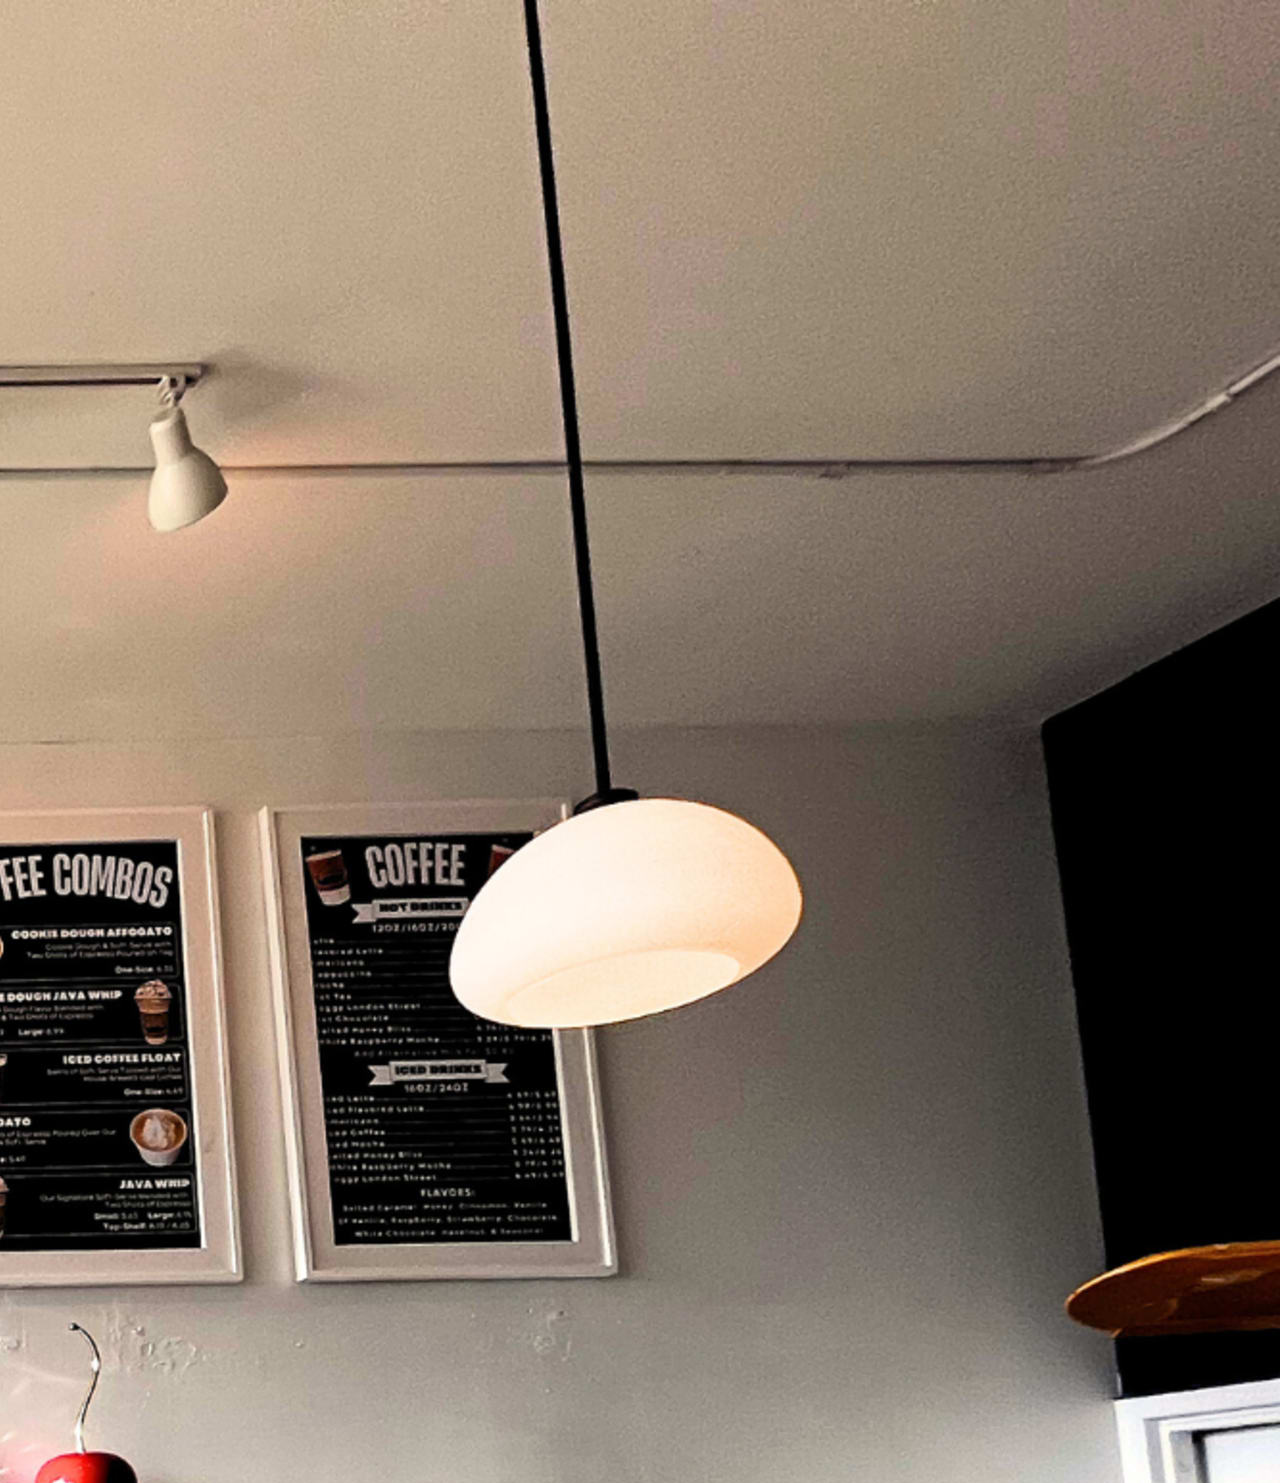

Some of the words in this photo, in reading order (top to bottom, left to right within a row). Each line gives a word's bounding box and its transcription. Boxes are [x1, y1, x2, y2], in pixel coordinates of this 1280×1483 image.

[365, 843, 466, 888] COFFEE
[52, 853, 173, 907] COMBOS
[379, 903, 407, 913] HOT
[410, 902, 463, 911] DRINKS
[11, 930, 58, 939] COOKIE
[107, 927, 172, 937] AFFOGATO
[8, 992, 51, 1002] DOUGH
[54, 992, 85, 1001] JAVA
[88, 991, 122, 999] WHIP
[63, 1055, 92, 1064] ICED
[94, 1054, 139, 1063] COFFEE
[141, 1053, 180, 1062] FLOAT
[395, 1066, 426, 1075] ICED
[120, 1180, 153, 1189] JAVA
[155, 1179, 190, 1188] WHIP
